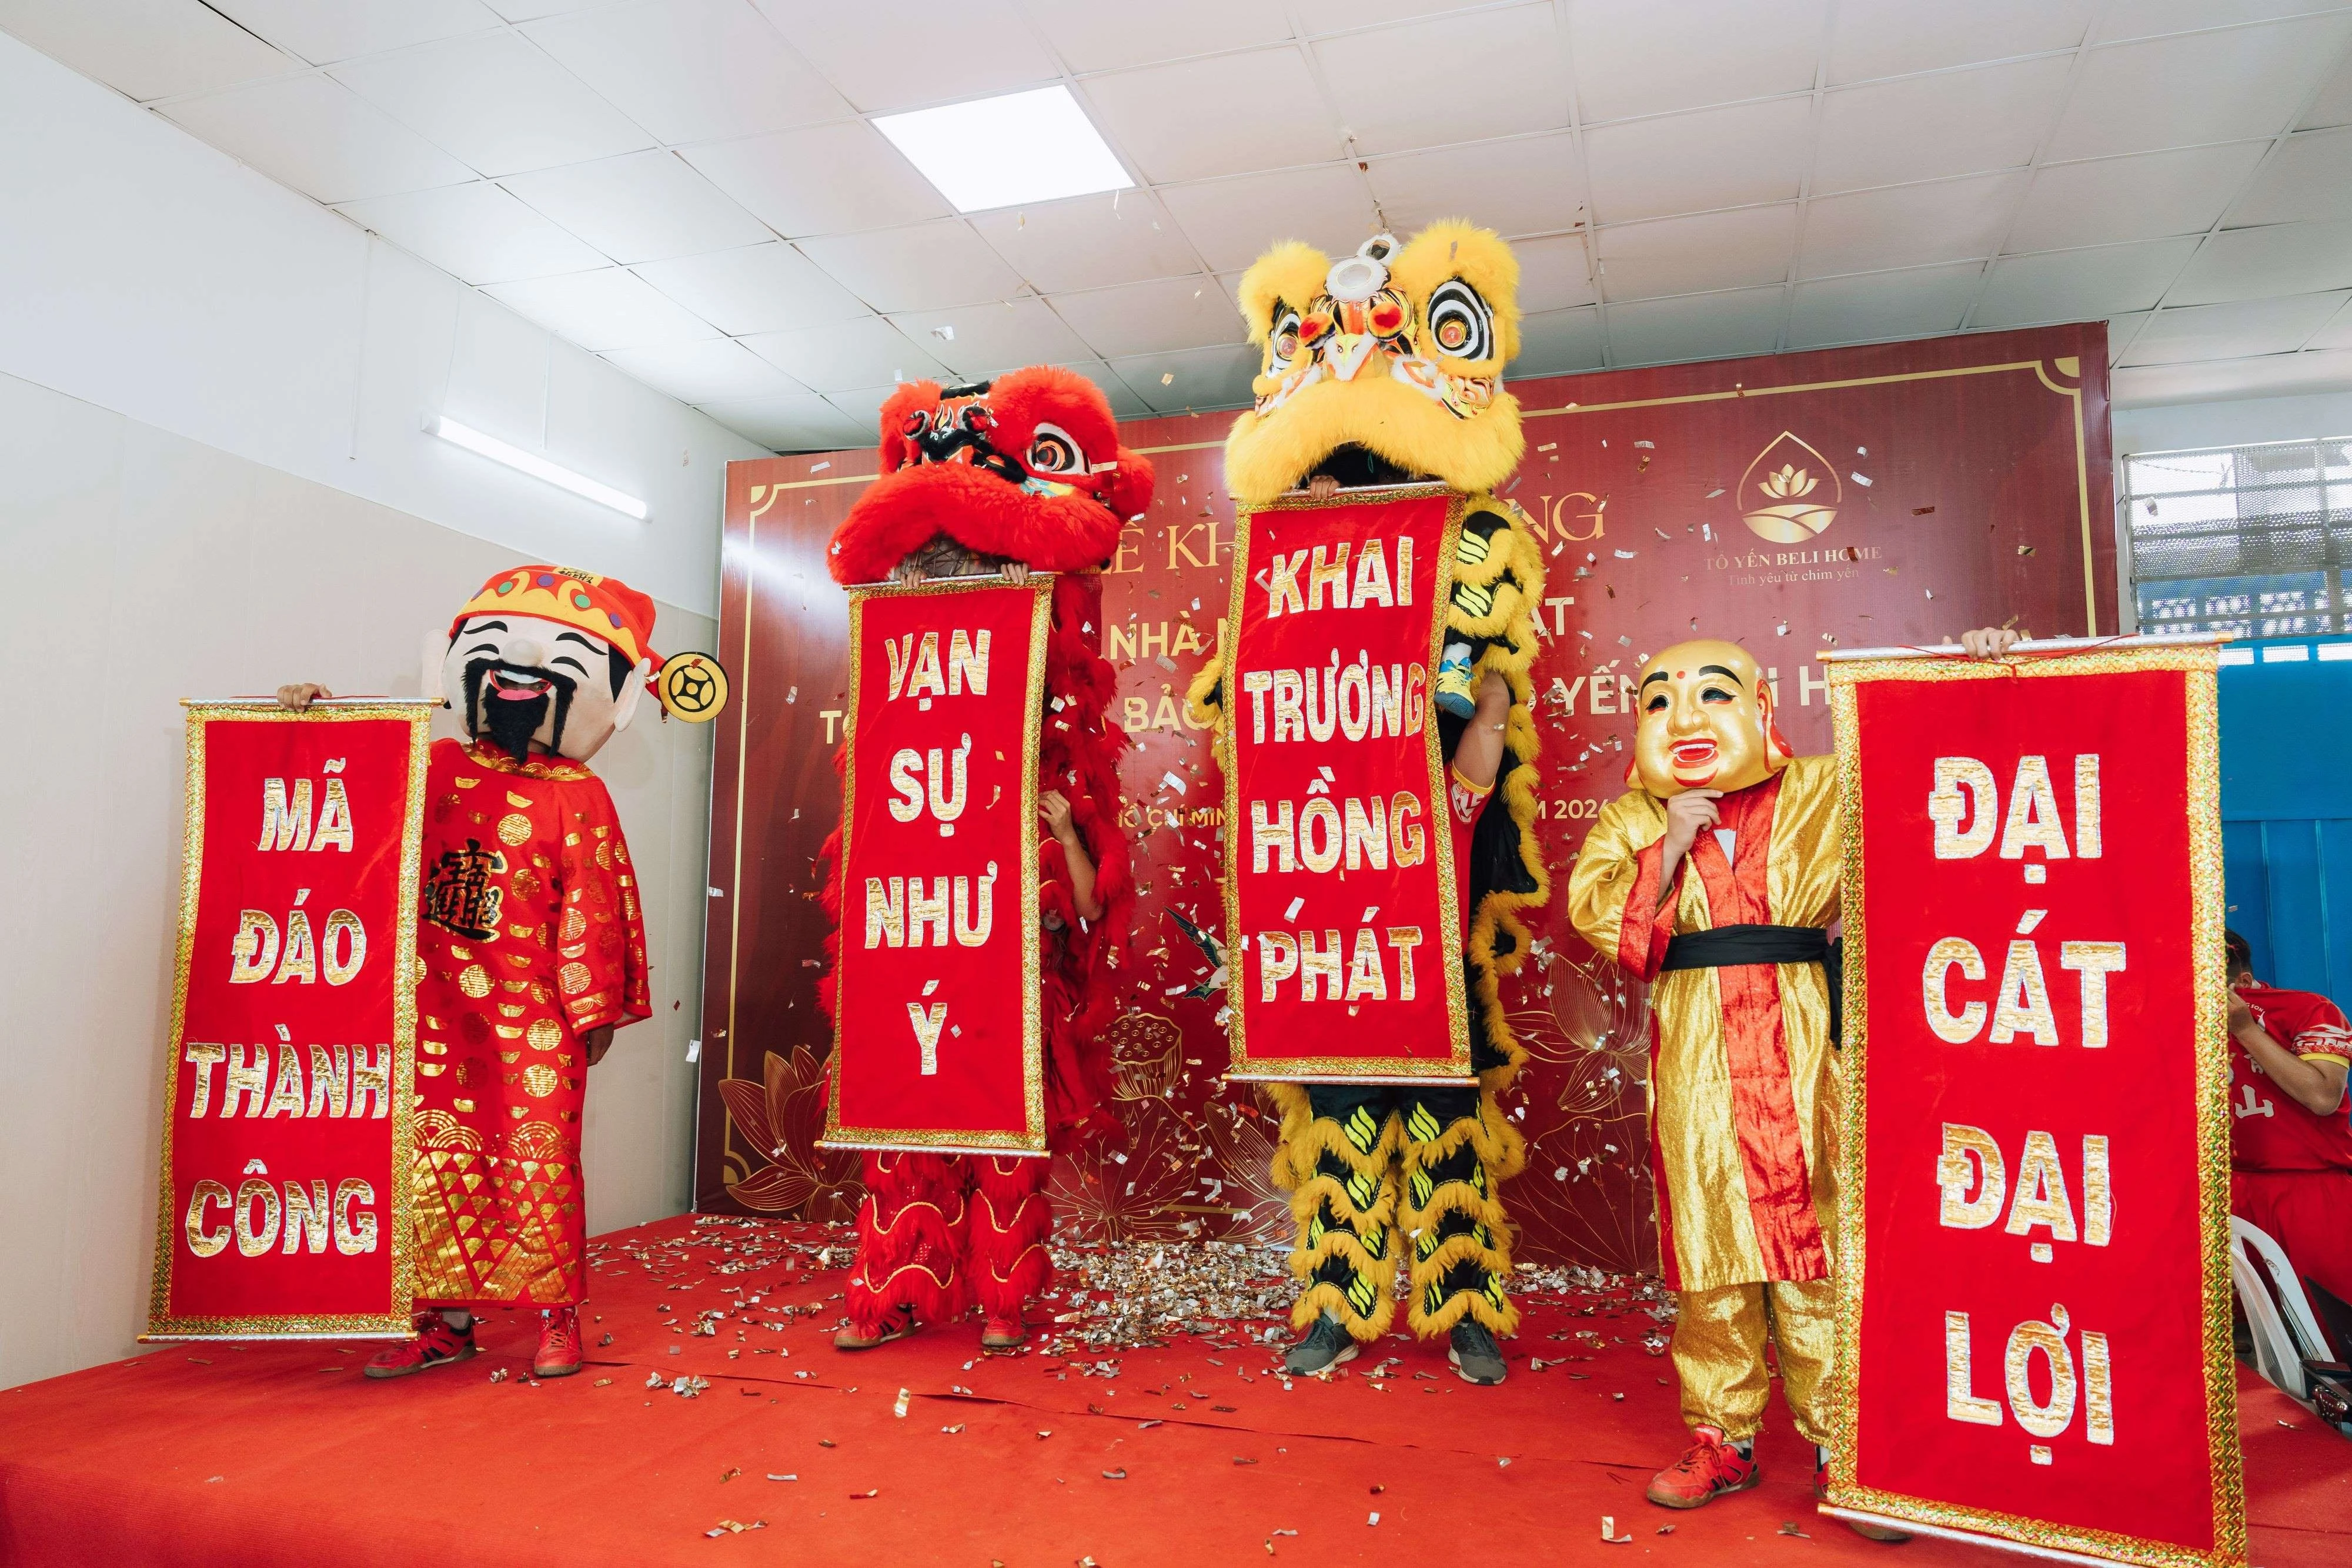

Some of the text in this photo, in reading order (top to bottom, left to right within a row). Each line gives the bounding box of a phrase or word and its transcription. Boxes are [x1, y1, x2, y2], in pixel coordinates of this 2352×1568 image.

[1267, 536, 1414, 618] KHAI
[1734, 548, 1770, 568] YẾN
[1776, 551, 1818, 566] BELI
[1825, 547, 1882, 562] HOME
[1759, 573, 1781, 586] yêu
[1802, 569, 1833, 580] chim
[885, 629, 991, 711] VẠN
[1110, 611, 1200, 659] NHÀ
[1244, 648, 1426, 744] TRƯƠNG
[257, 758, 353, 852] MÃ
[888, 733, 971, 837] SỰ
[1190, 808, 1225, 827] MIN
[1252, 766, 1425, 873] HỒNG
[1928, 754, 2102, 884] ĐẠI
[229, 888, 367, 986] ĐÁO
[864, 861, 997, 949] NHƯ
[1260, 906, 1422, 1002] PHÁT
[1922, 910, 2126, 1048] CÁT
[186, 1024, 390, 1119] THÀNH
[907, 979, 948, 1075] Ý
[185, 1159, 378, 1258] CÔNG
[1936, 1122, 2113, 1263] ĐẠI
[1945, 1303, 2114, 1465] LỢI
